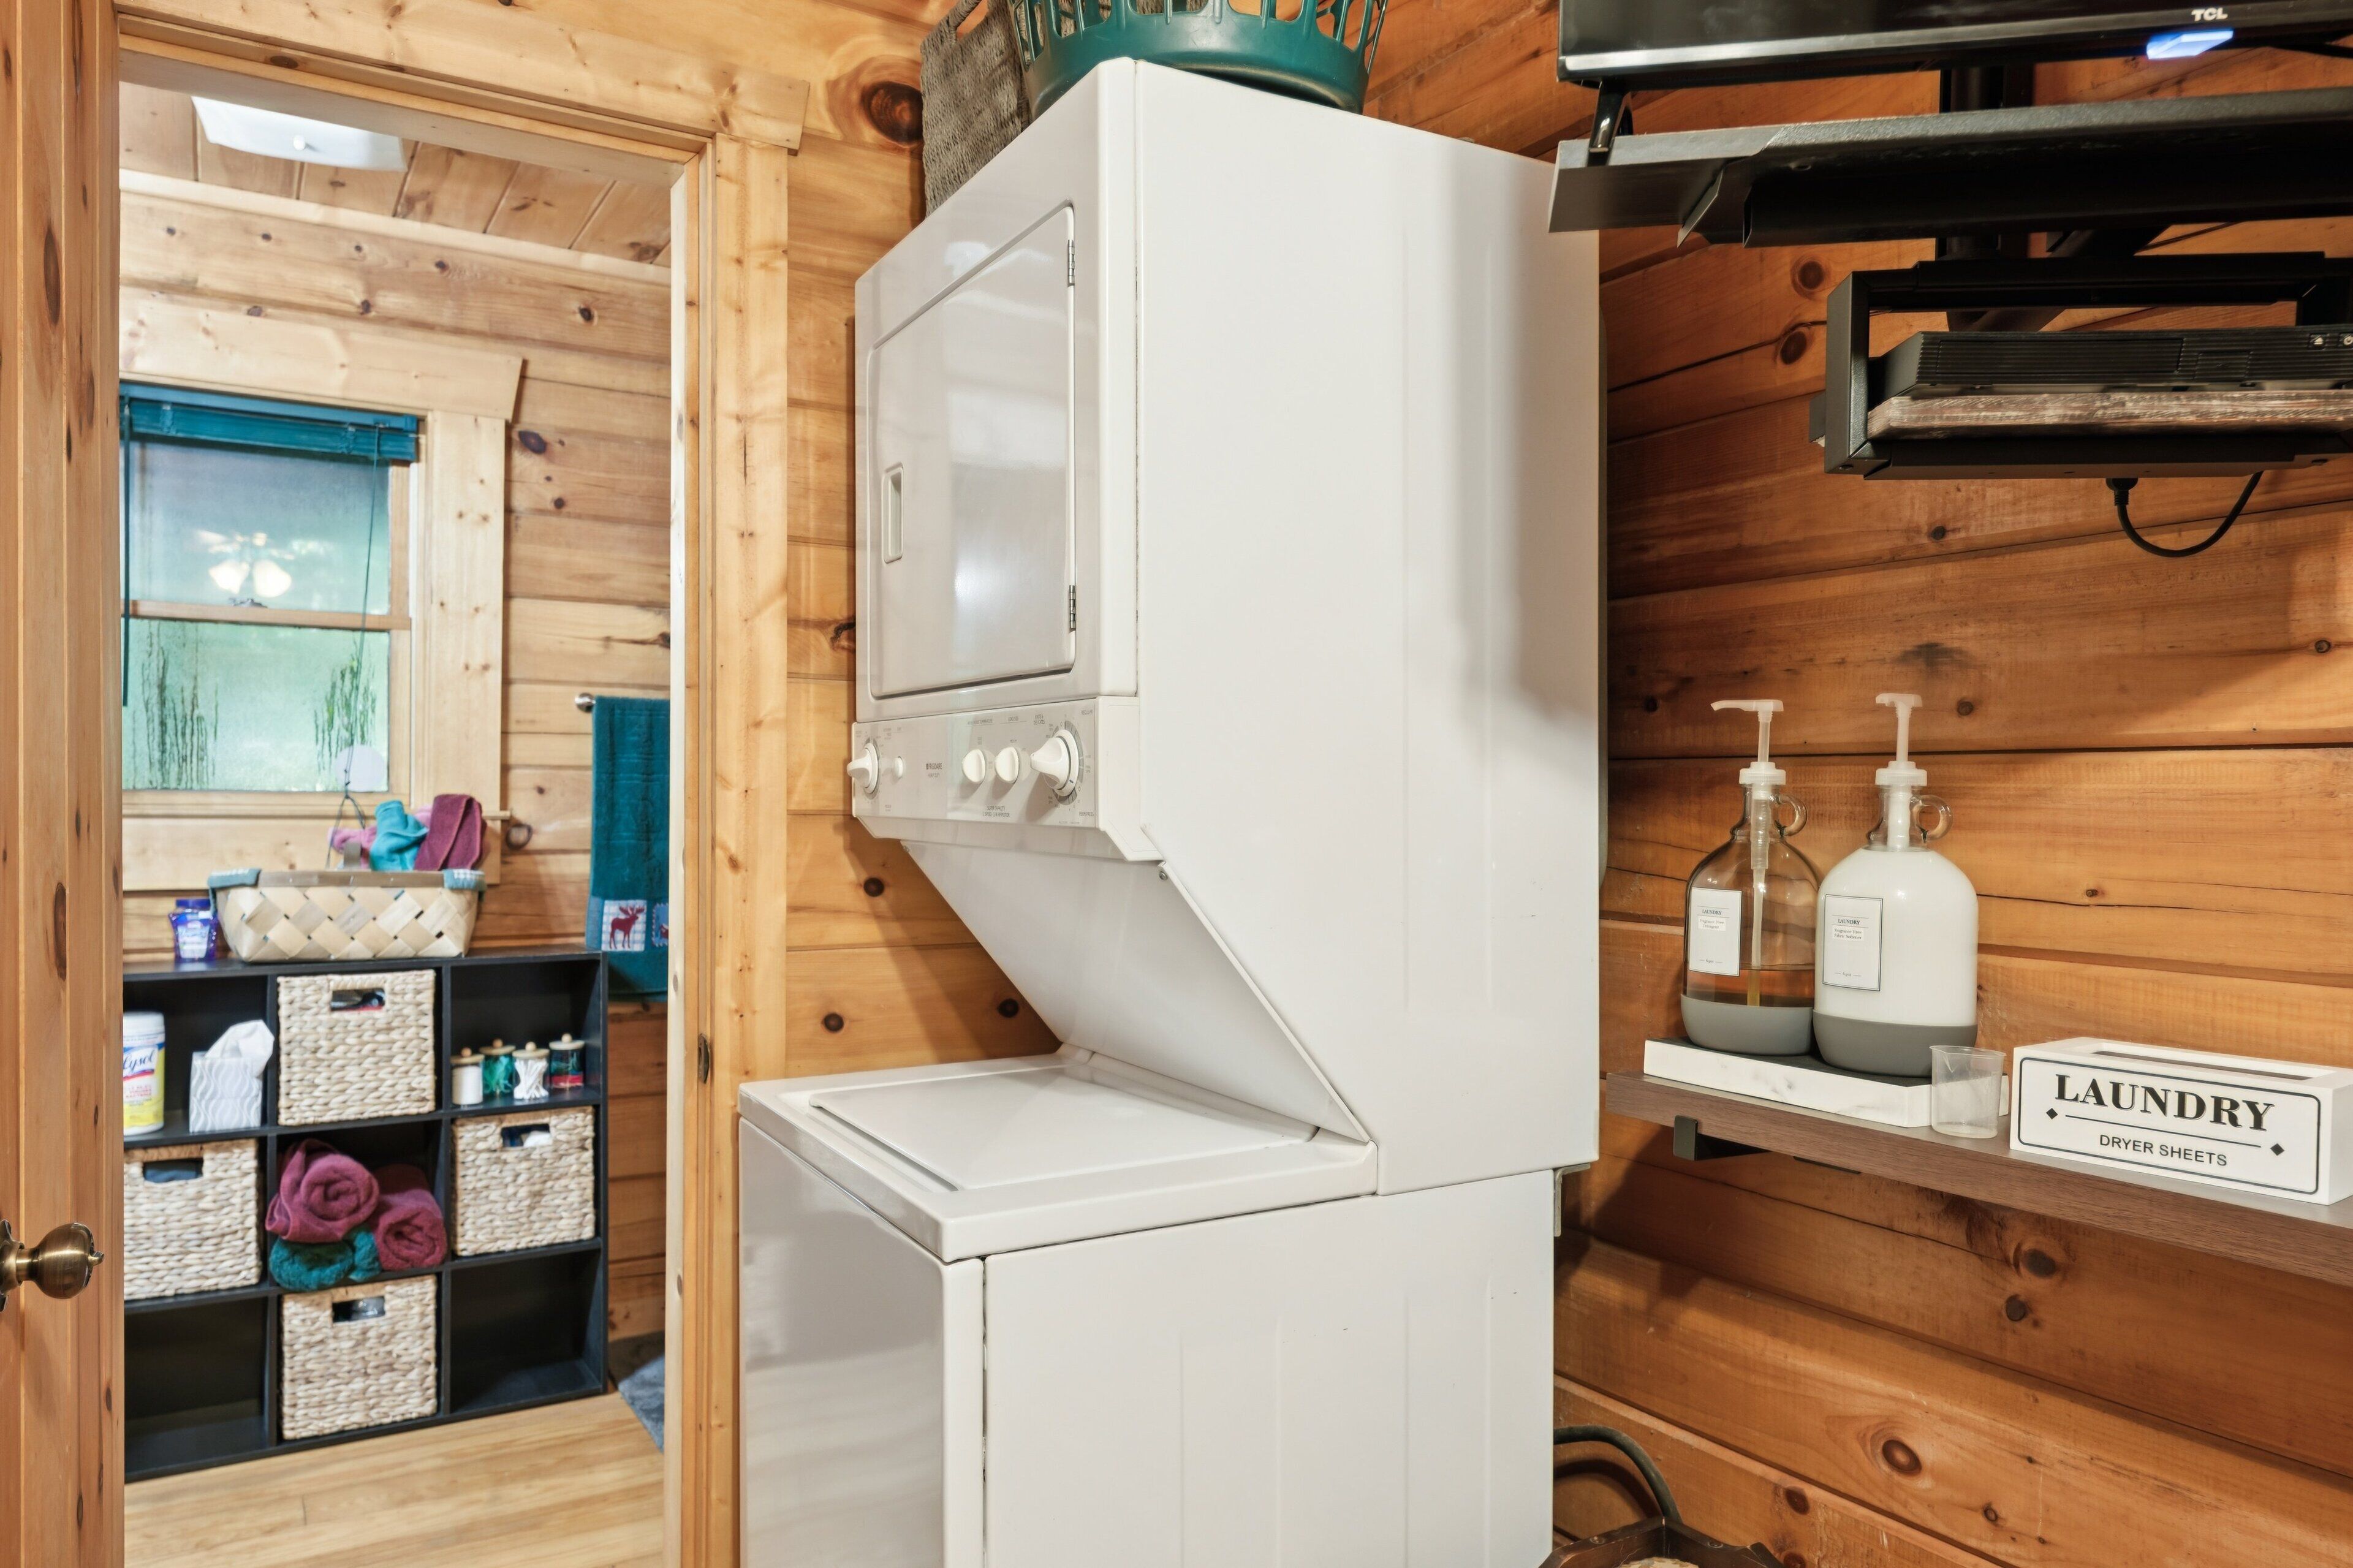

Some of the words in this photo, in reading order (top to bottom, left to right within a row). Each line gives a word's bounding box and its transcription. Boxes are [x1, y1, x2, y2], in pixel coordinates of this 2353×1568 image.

[2191, 7, 2228, 21] TCL
[2055, 1074, 2275, 1132] LAUNDRY
[2099, 1134, 2154, 1154] DRYER
[2159, 1144, 2228, 1167] SHEETS
